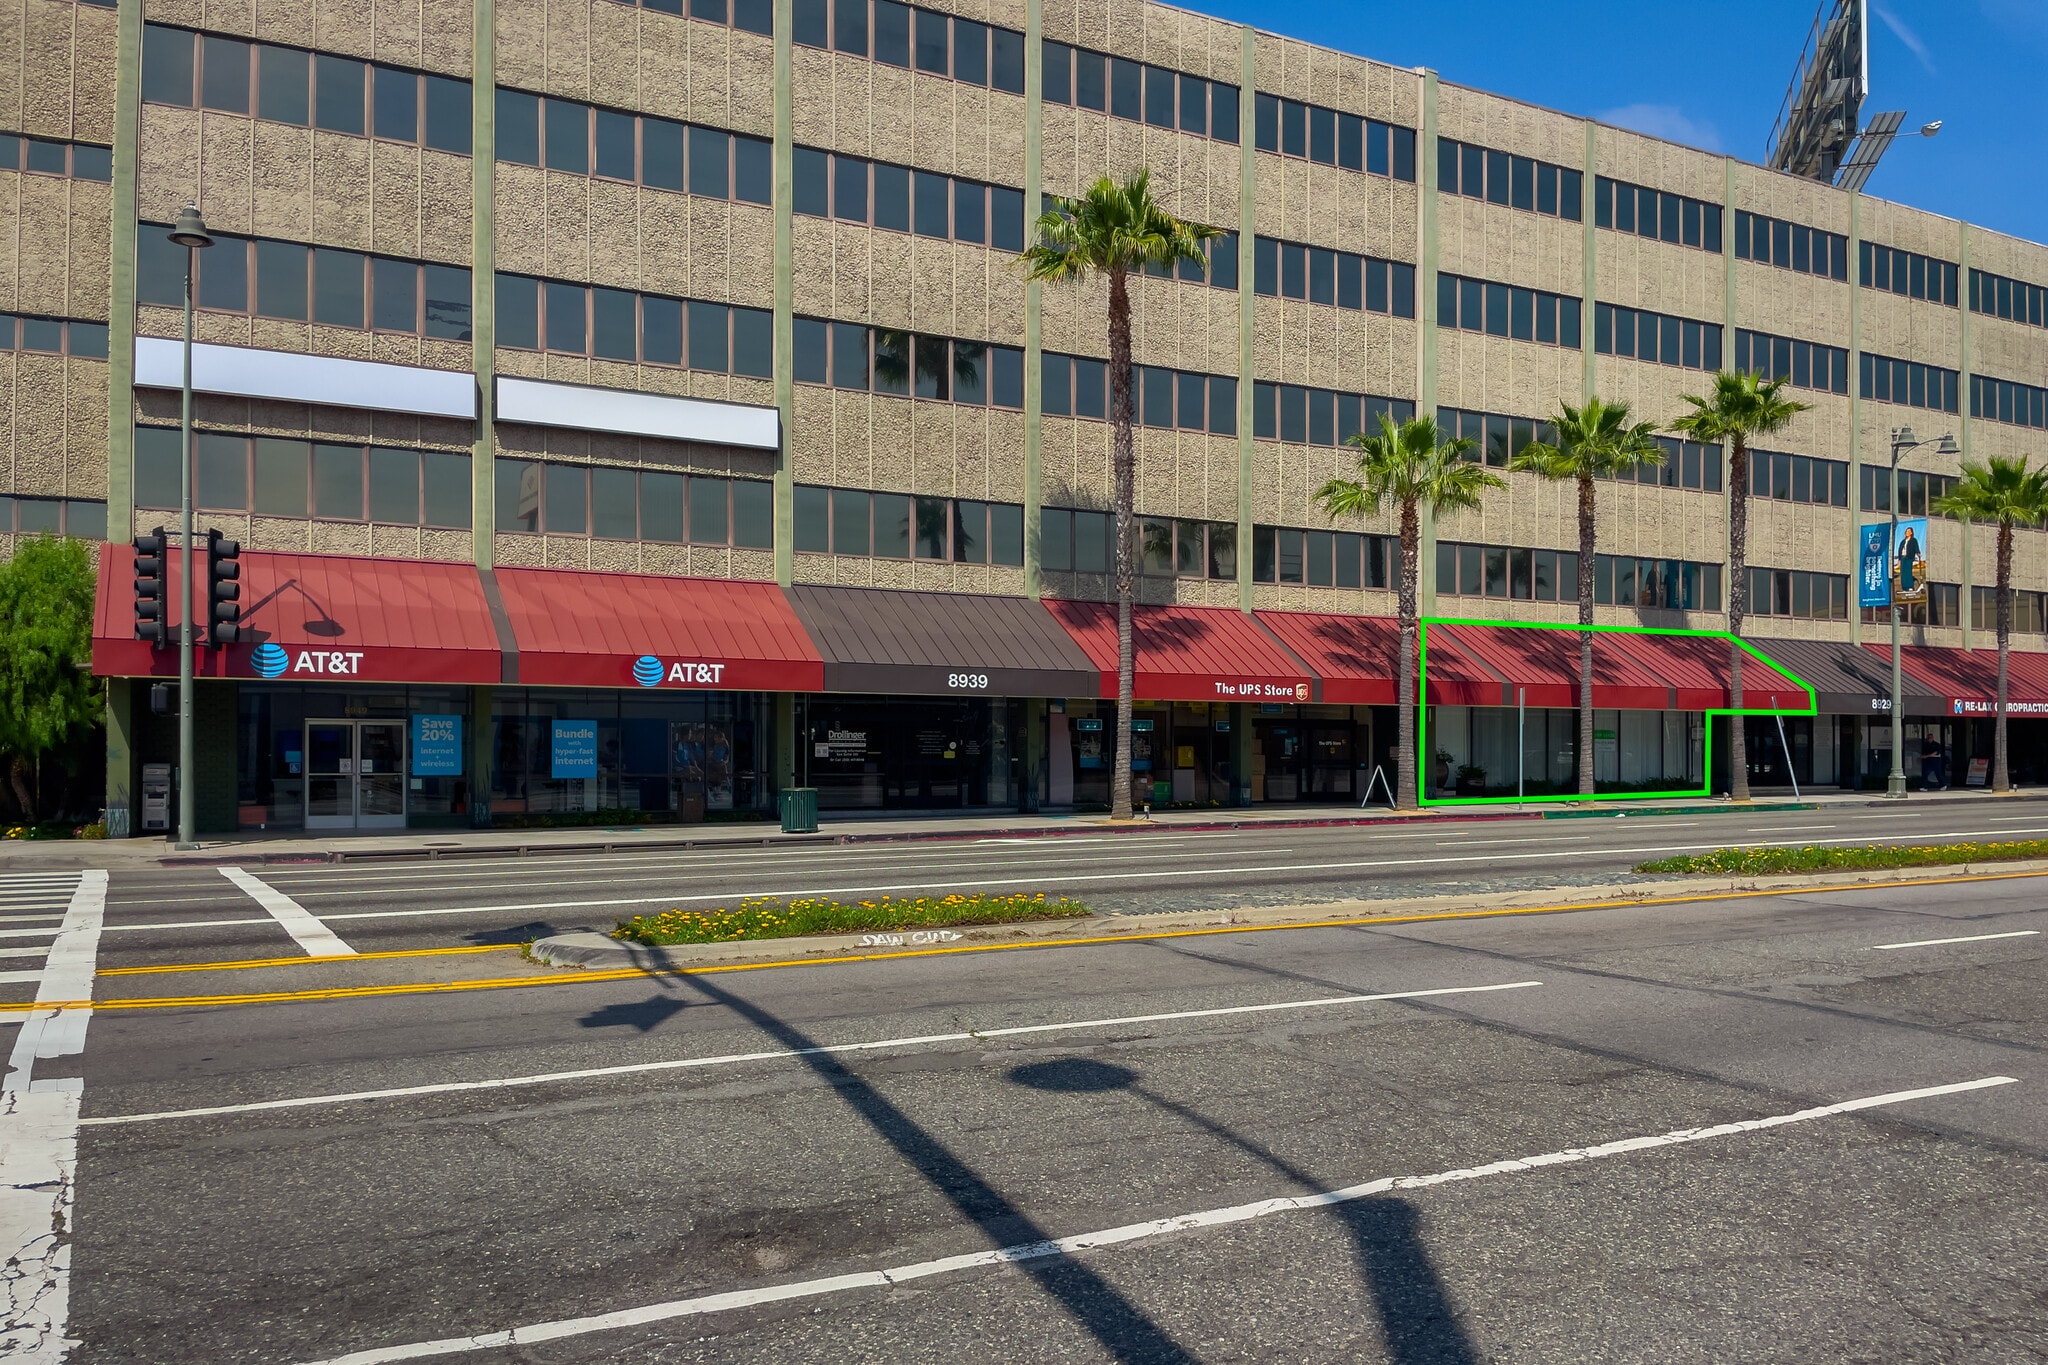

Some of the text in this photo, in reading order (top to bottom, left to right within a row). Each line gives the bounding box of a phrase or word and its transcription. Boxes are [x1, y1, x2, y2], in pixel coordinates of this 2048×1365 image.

[294, 651, 364, 674] AT&T
[668, 663, 725, 683] AT&T
[948, 673, 988, 689] 8939
[1215, 682, 1293, 696] The UPS Store
[1872, 698, 1892, 710] 8929
[421, 718, 454, 729] Save
[421, 729, 455, 741] 20%
[555, 729, 594, 738] Bundle
[828, 730, 867, 741] Drollinger
[858, 931, 951, 947] SAW CUT
